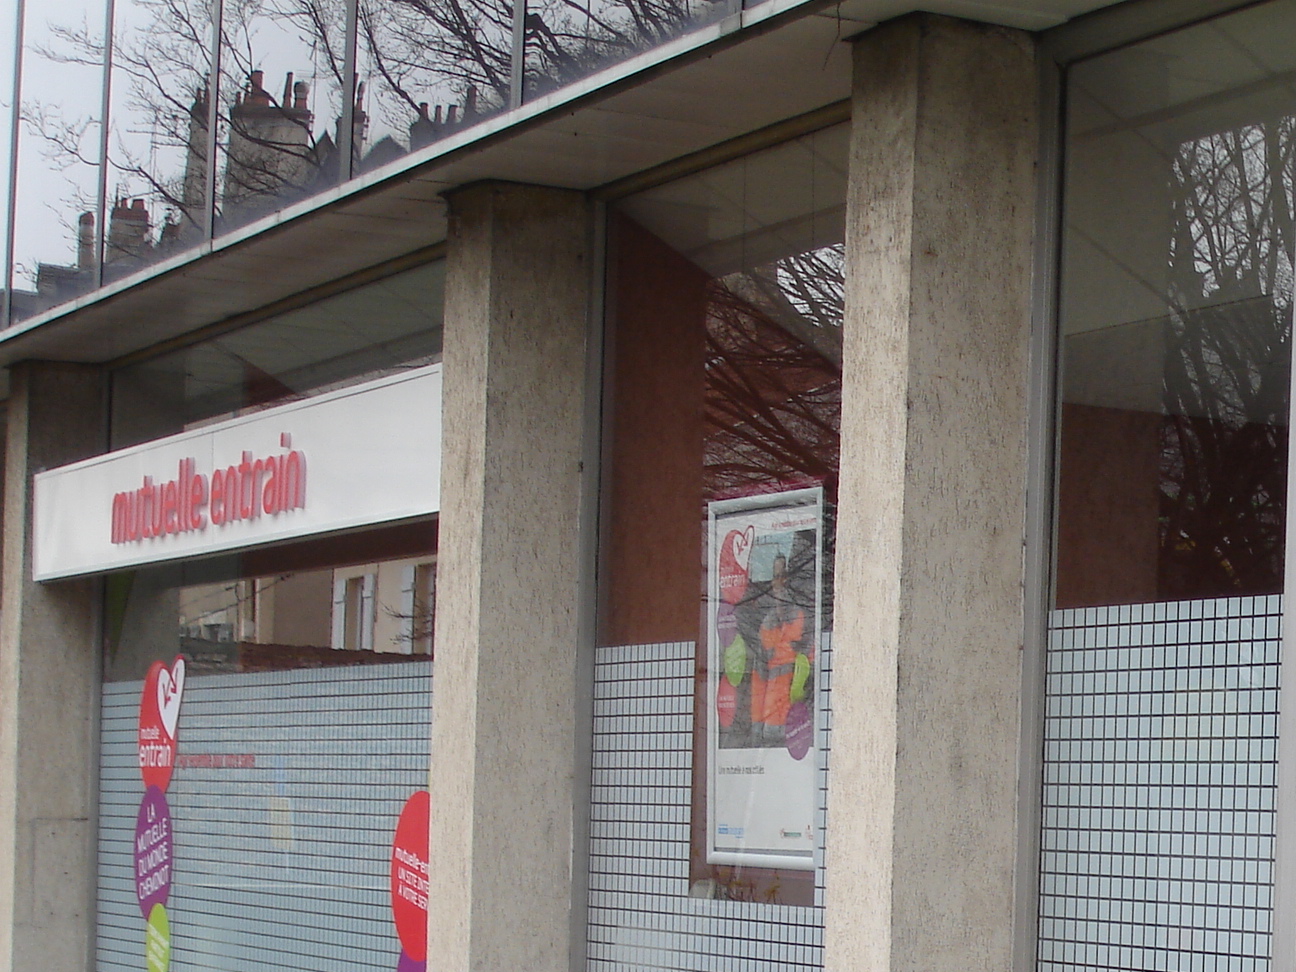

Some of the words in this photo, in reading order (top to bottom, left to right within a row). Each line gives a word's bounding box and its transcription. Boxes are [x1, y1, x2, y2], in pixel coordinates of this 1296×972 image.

[111, 457, 209, 544] mutuelle
[210, 432, 306, 526] entrain
[139, 738, 171, 767] entrain
[146, 802, 156, 823] LA
[137, 817, 168, 853] MUTUELLE
